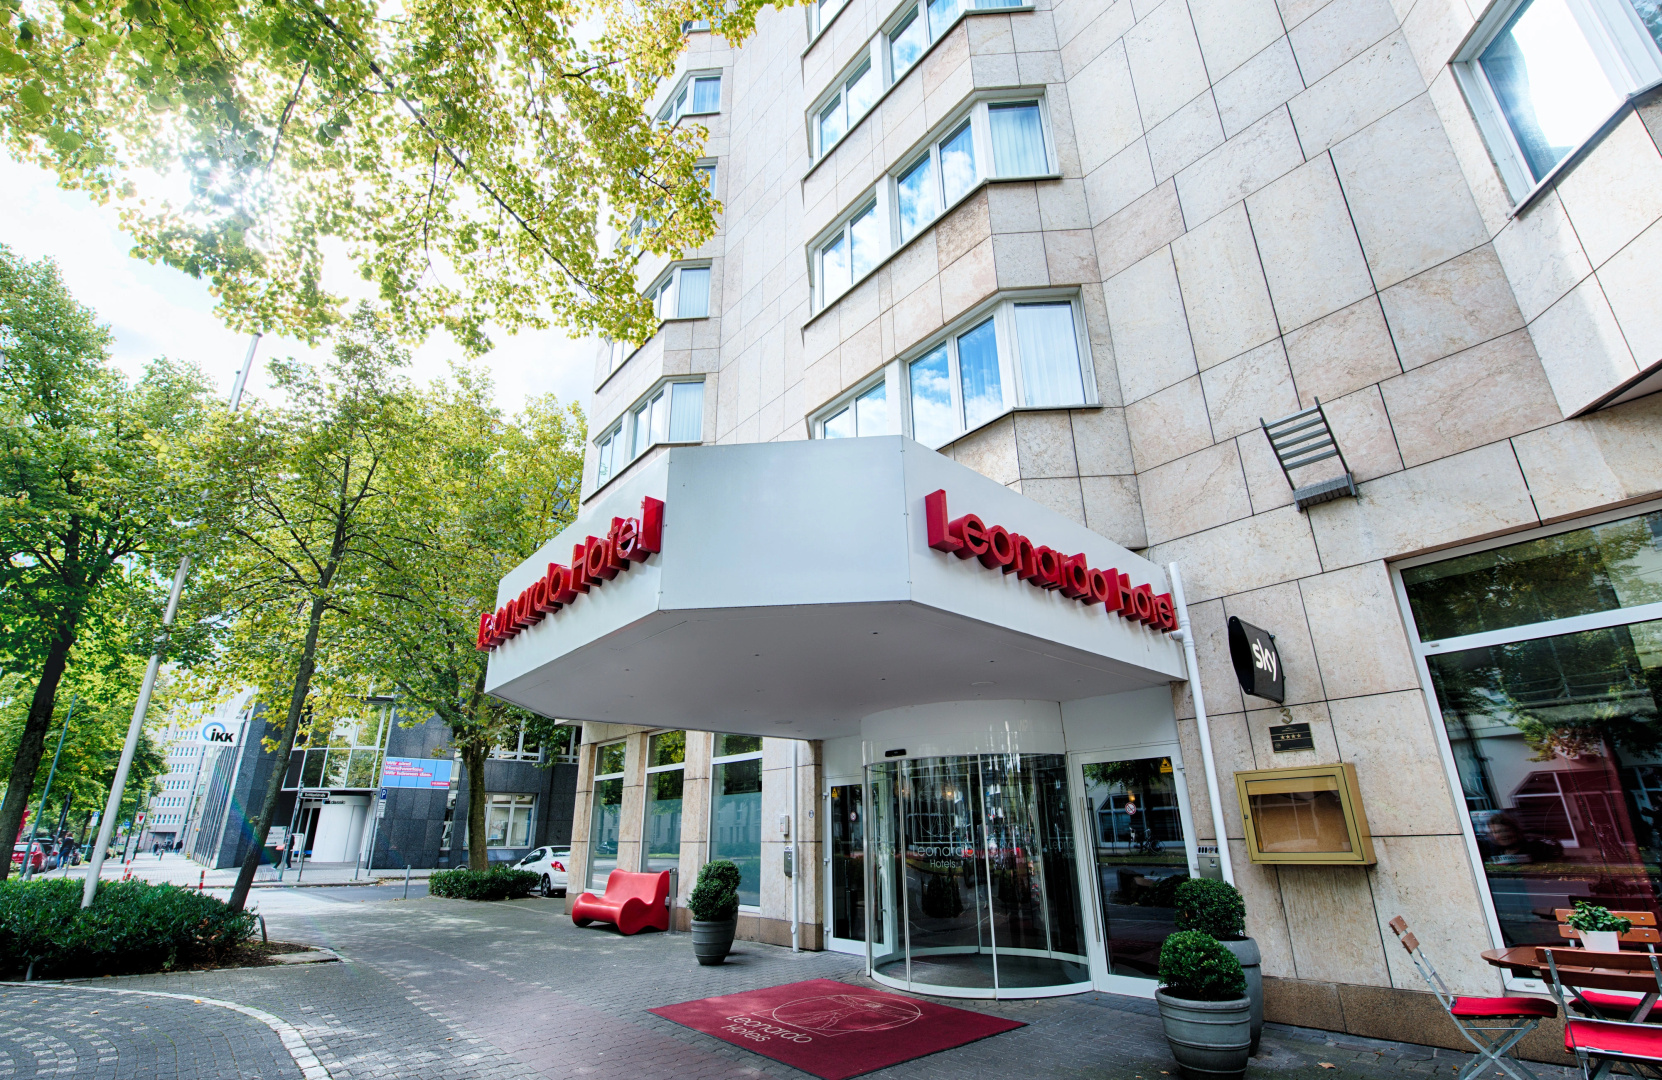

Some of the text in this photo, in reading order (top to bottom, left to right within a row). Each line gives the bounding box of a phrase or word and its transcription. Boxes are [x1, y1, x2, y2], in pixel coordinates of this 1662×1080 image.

[925, 489, 1179, 634] Leonardo Hotel
[476, 495, 664, 652] Leonardo Hotel
[1252, 638, 1277, 682] sky
[1280, 707, 1293, 724] 3
[913, 843, 974, 858] Leonardo
[930, 859, 956, 869] Hotels
[721, 1024, 771, 1042] Hotels
[726, 1014, 812, 1043] Leonardo
